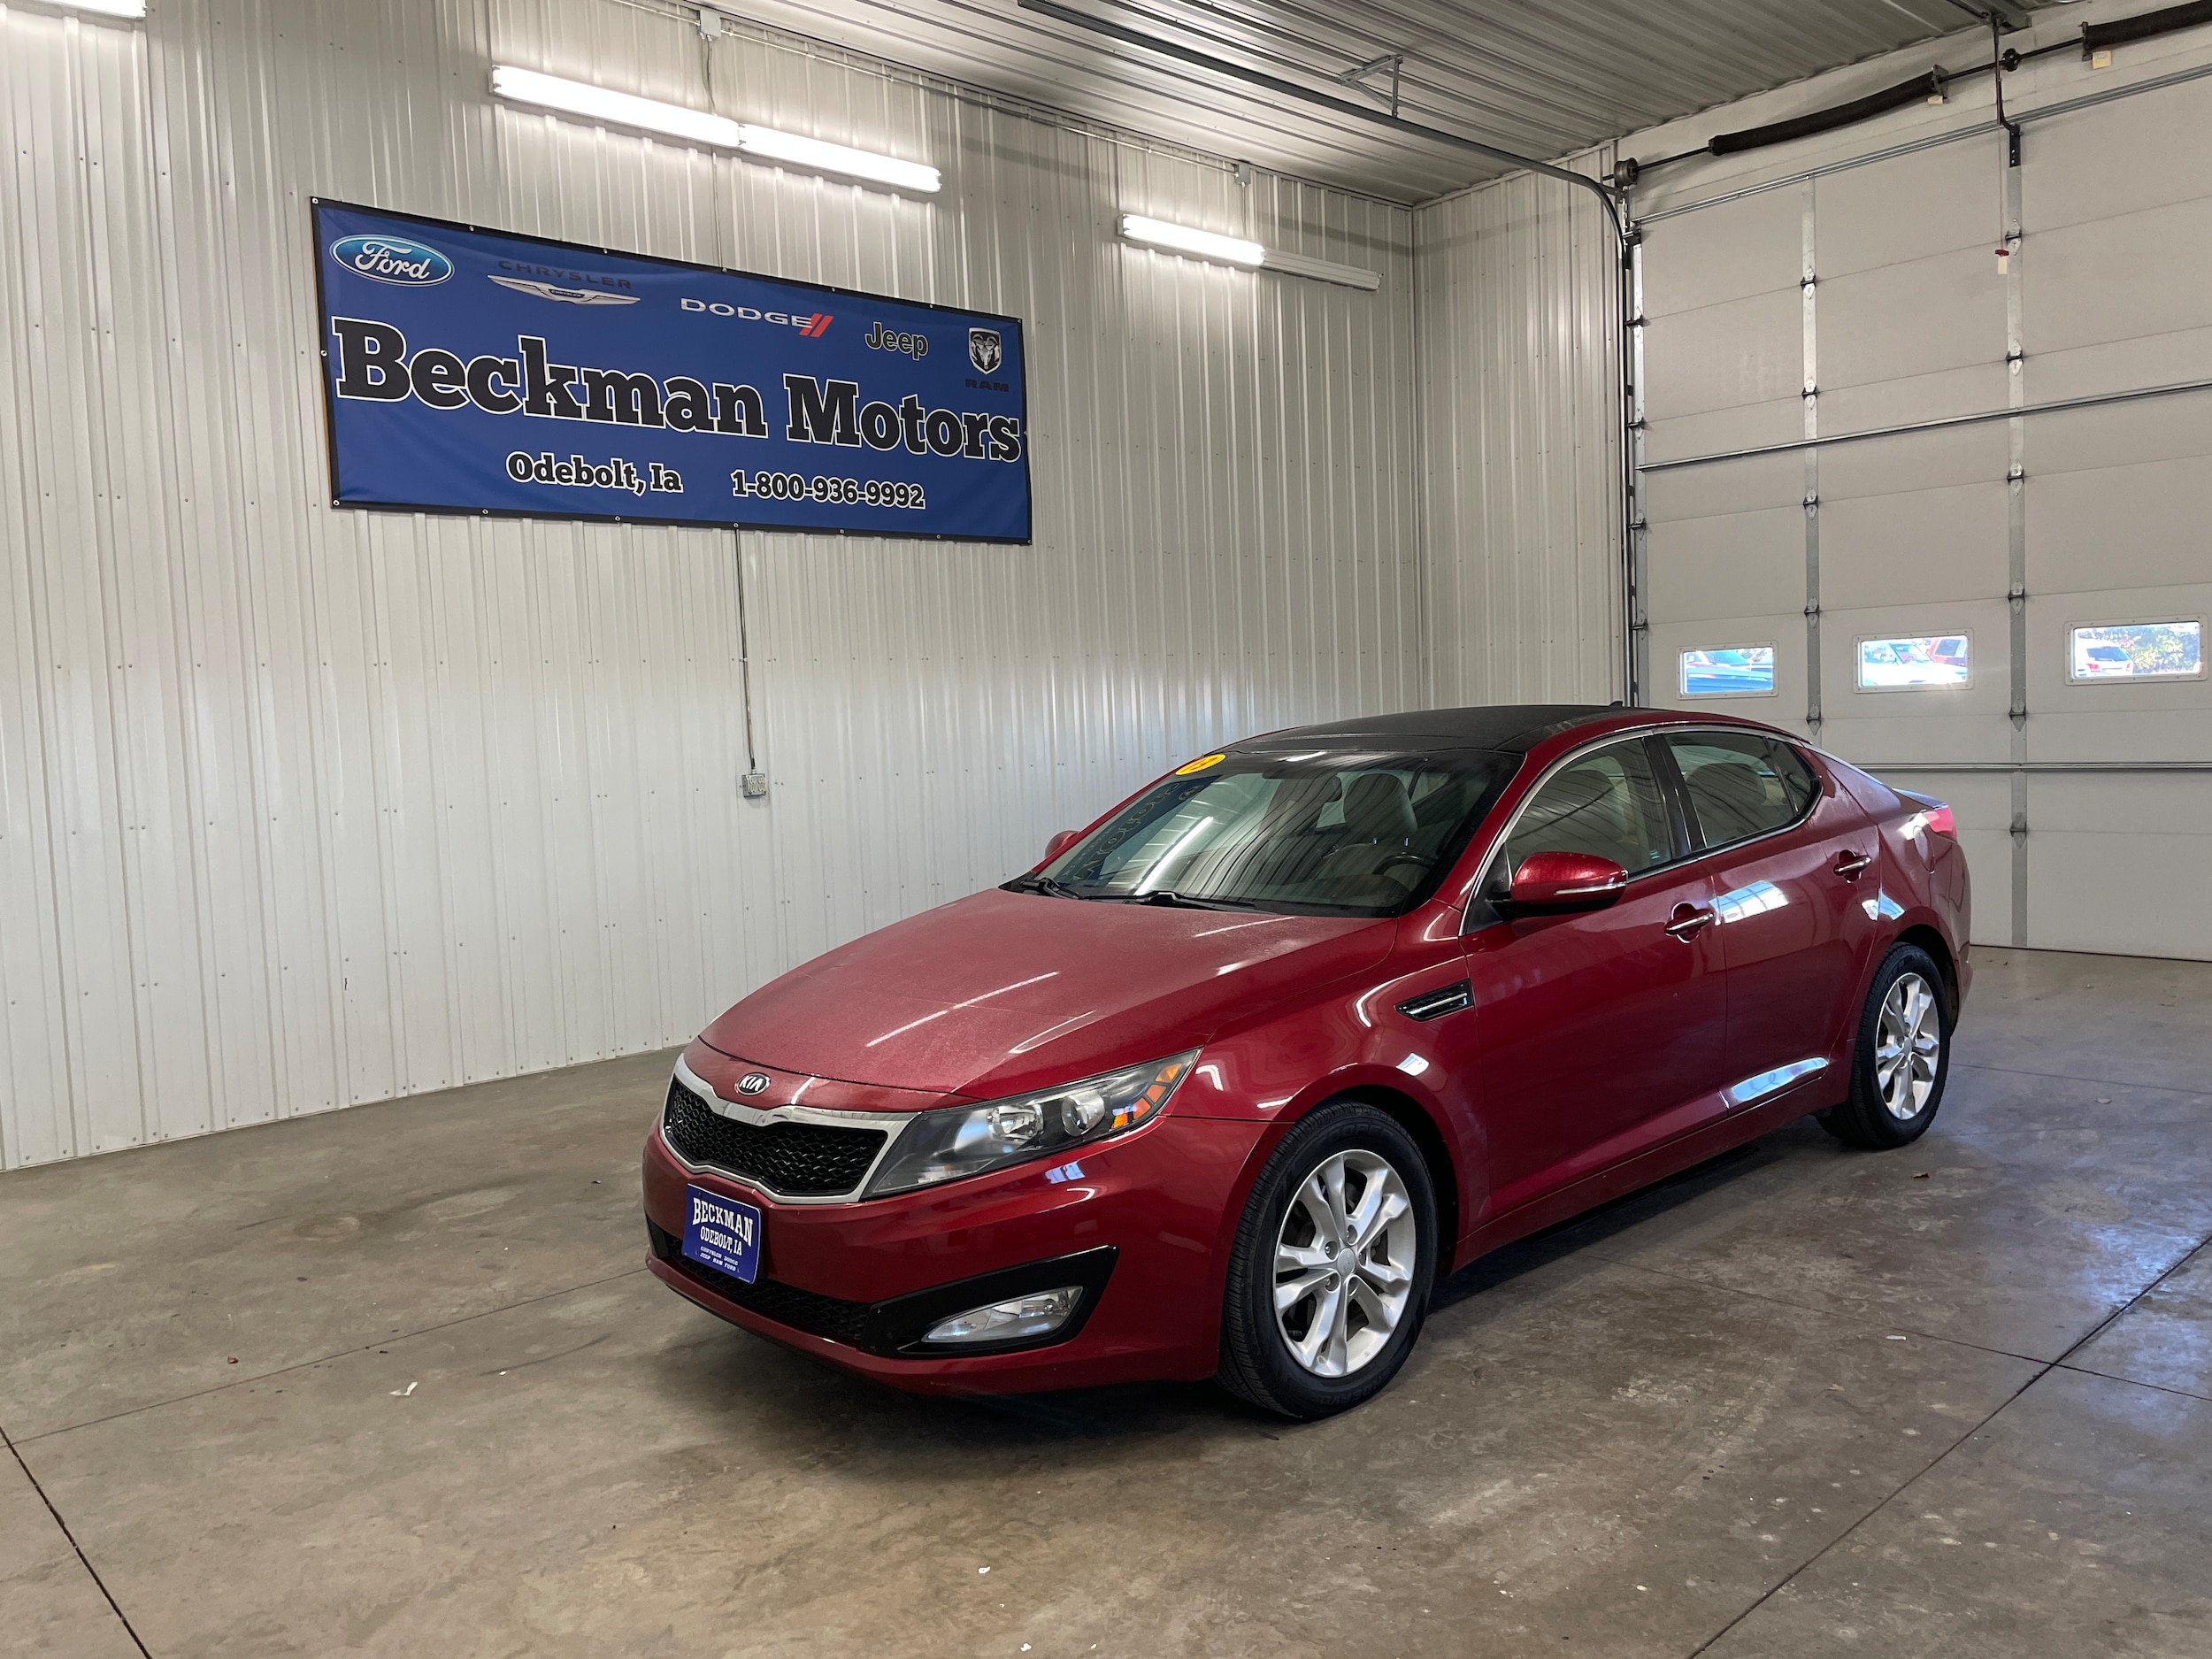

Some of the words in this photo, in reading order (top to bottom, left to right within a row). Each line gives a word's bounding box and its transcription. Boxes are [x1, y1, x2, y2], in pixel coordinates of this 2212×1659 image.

[355, 241, 432, 280] Ford
[498, 259, 632, 289] CHRYSLER
[680, 297, 813, 329] DODGE
[865, 321, 929, 360] Jeep
[331, 316, 768, 439] Beckman
[782, 373, 1022, 463] Motors
[965, 378, 1010, 393] RAM
[506, 451, 645, 497] Odebolt,
[649, 463, 684, 494] Ia
[730, 469, 926, 510] 1-800-936-9992
[739, 1075, 764, 1092] KIA
[692, 1197, 753, 1248] BECKMAN
[700, 1225, 733, 1254] ODEBOLT,
[733, 1240, 742, 1256] IA
